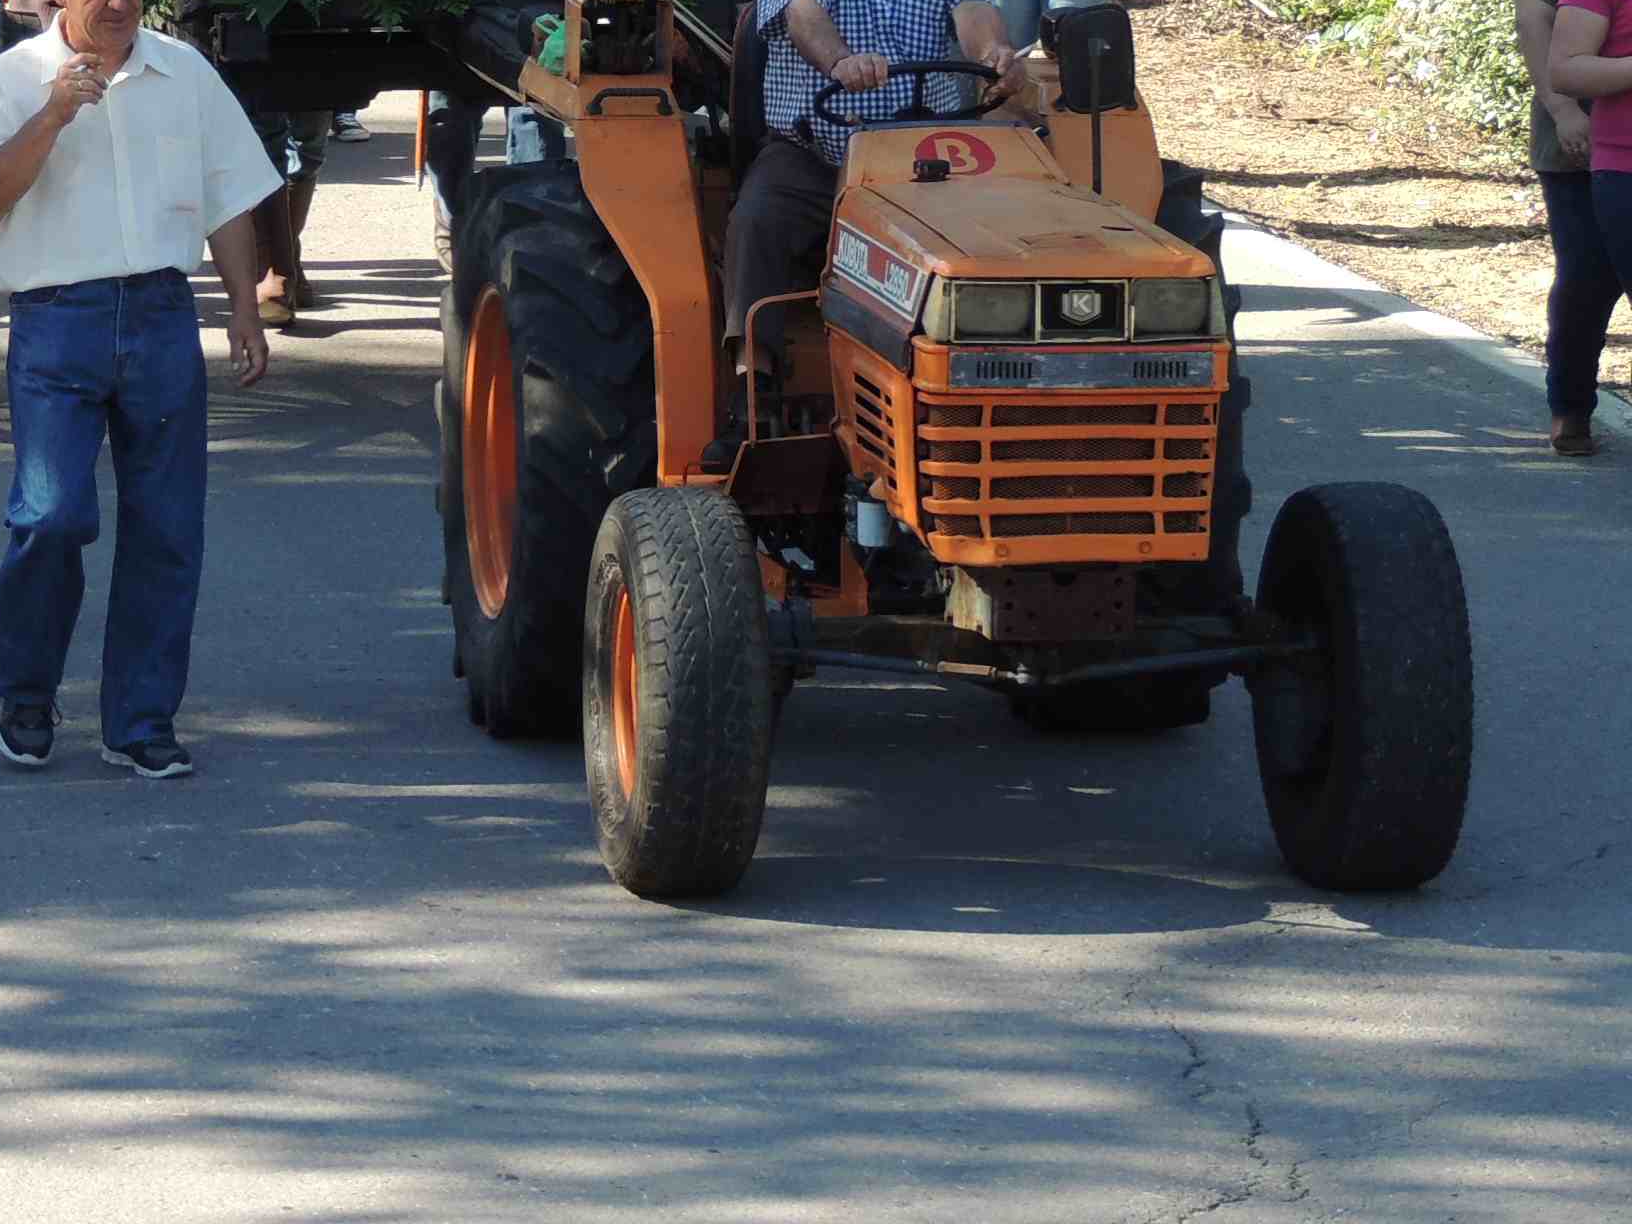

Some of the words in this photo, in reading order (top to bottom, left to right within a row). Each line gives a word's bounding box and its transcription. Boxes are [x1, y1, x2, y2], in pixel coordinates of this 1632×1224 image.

[934, 137, 979, 173] B
[837, 229, 869, 280] KUBOTA
[1071, 293, 1092, 314] K
